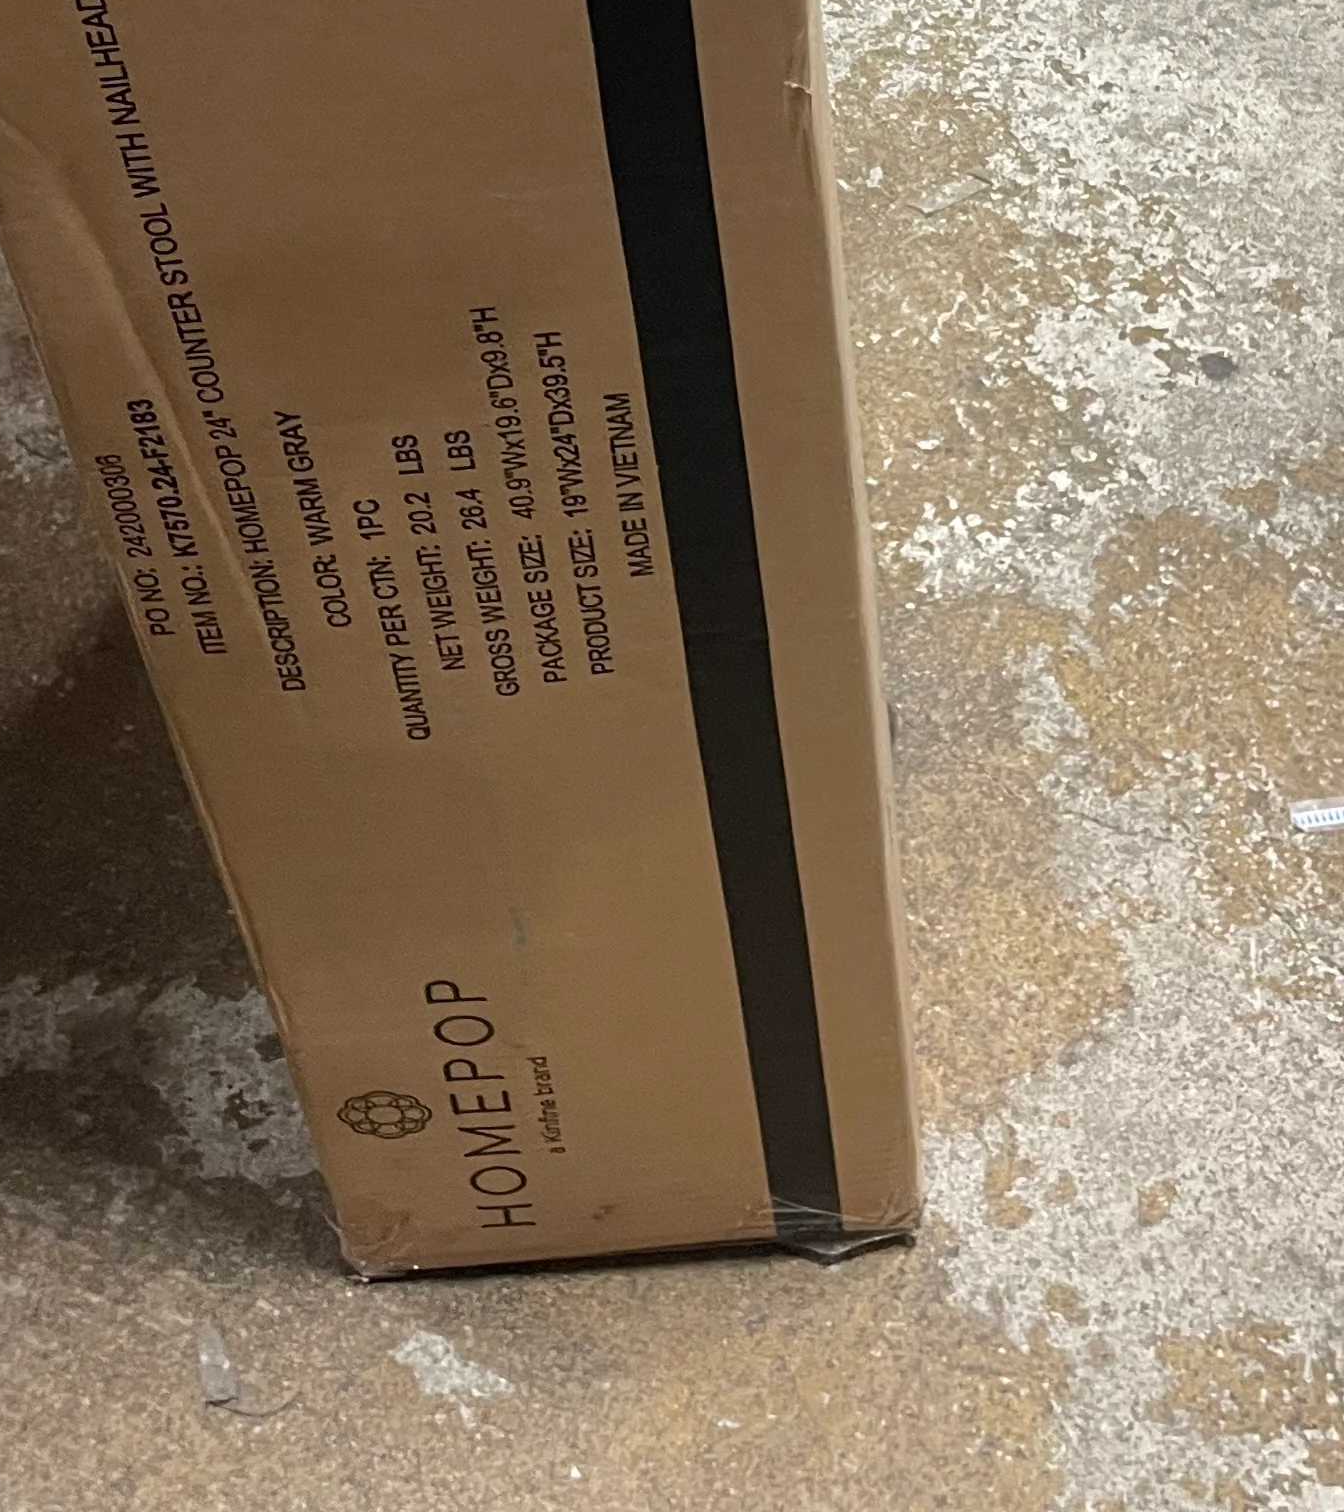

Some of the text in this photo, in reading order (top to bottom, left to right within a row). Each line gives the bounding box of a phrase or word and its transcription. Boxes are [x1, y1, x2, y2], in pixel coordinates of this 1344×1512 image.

[116, 133, 161, 199] WITH
[140, 202, 189, 287] STOOL
[167, 290, 225, 405] COUNTER
[201, 410, 237, 441] 24"
[127, 399, 229, 655] ITEM NO.: K7570.24-F2183
[215, 444, 269, 554] HOMEPOP
[273, 410, 352, 628] COLOR: WARM GRAY
[603, 392, 655, 578] MADE IN VIETNAM
[94, 454, 175, 636] PO NO: 242000306
[391, 434, 466, 672] NET WEIGHT: 20.2 LBS
[444, 429, 520, 697] GROSS WEIGHT: 26.4 LBS
[517, 534, 549, 586] SIZE:
[567, 528, 598, 579] SIZE:
[250, 559, 307, 692] DESCRIPTION:
[353, 499, 431, 740] QUANTITY PER CTN: 1PC
[527, 589, 567, 684] PACKAGE
[577, 584, 615, 675] PRODUCT
[424, 980, 537, 1228] HOMEPOP
[526, 1055, 554, 1096] brand
